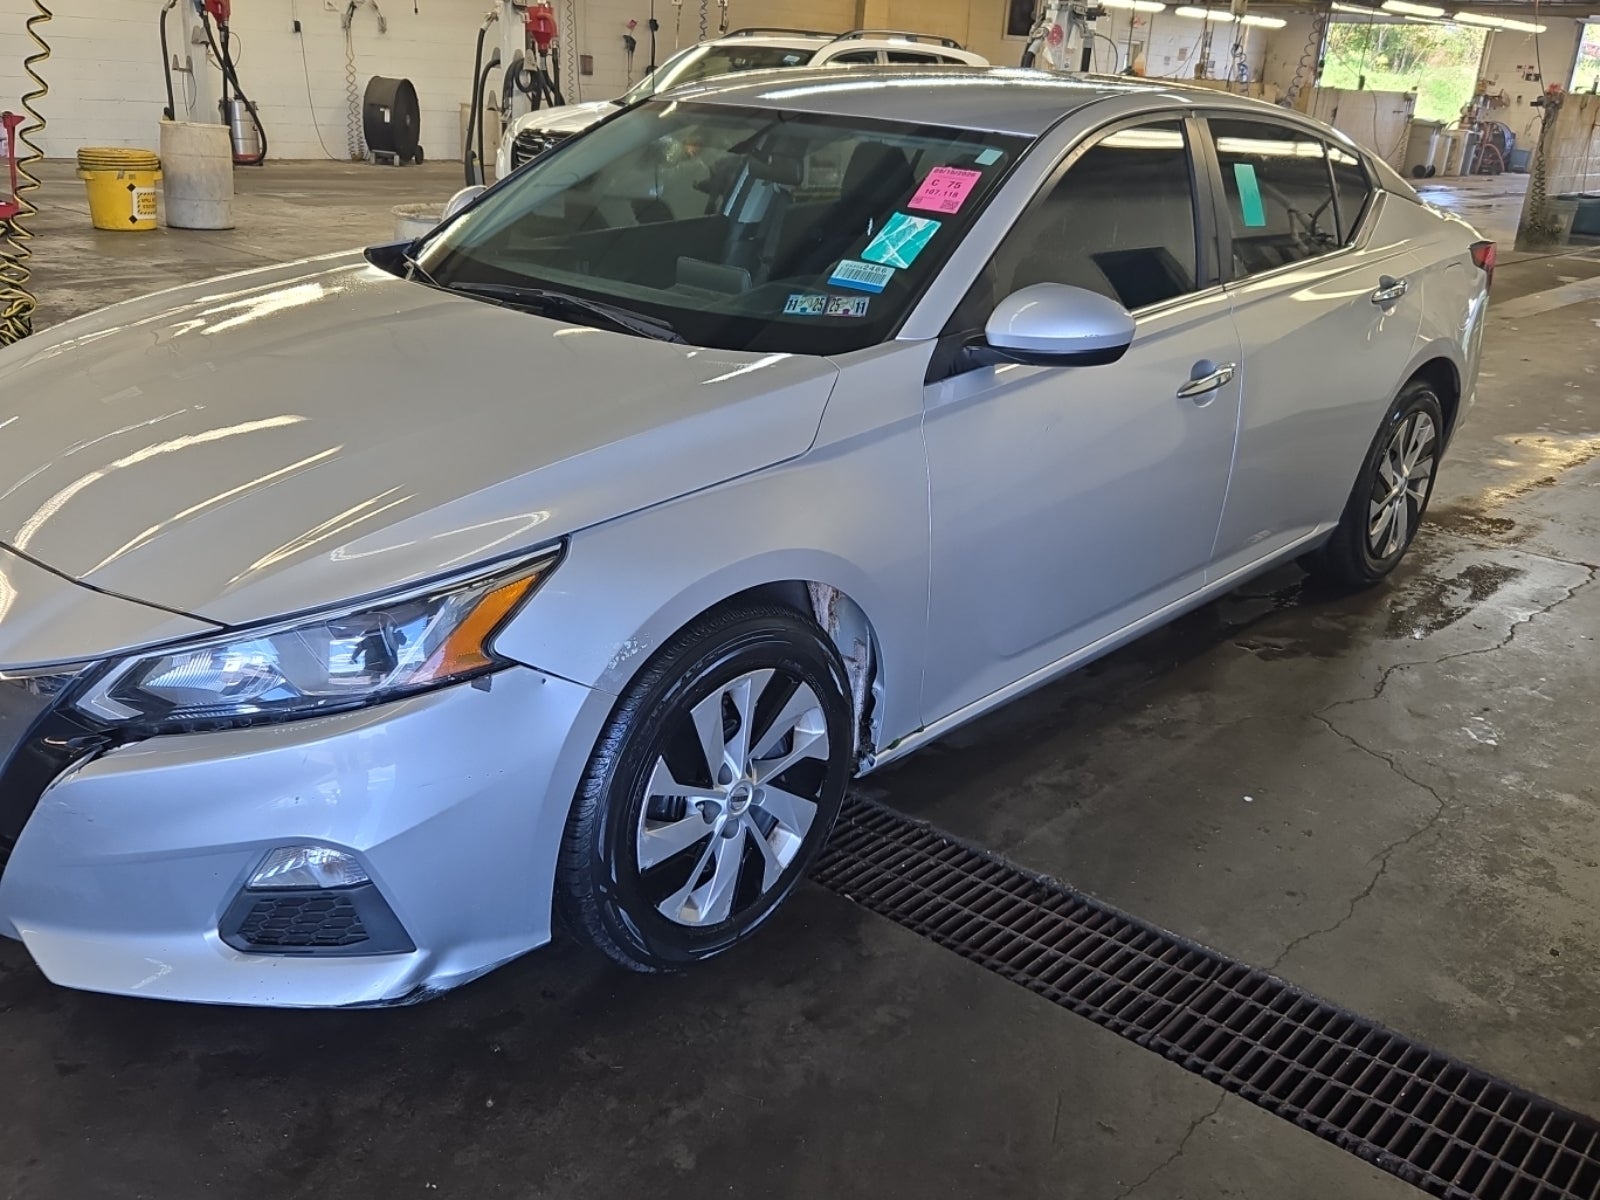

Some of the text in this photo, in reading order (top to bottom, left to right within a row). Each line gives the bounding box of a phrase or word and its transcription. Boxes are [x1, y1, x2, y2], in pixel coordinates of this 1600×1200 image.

[931, 179, 962, 189] C 75
[786, 297, 825, 312] 11 25
[829, 297, 866, 314] 25 11
